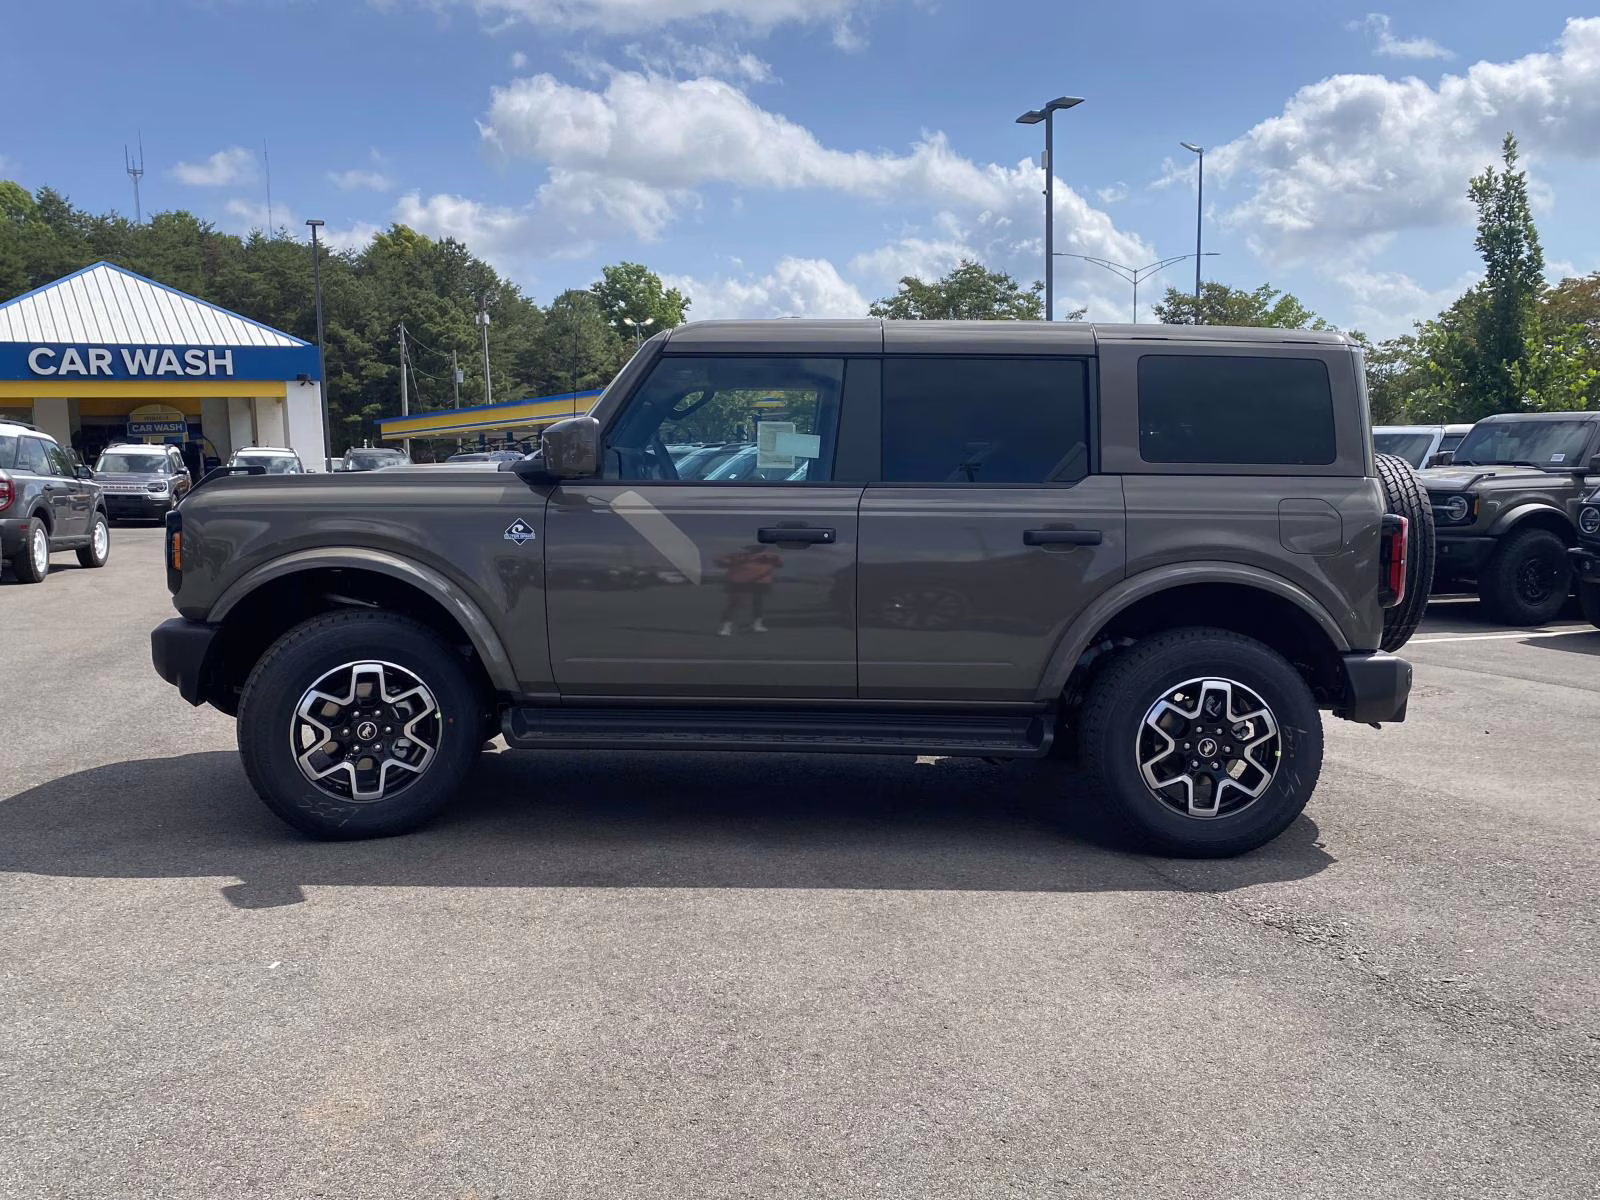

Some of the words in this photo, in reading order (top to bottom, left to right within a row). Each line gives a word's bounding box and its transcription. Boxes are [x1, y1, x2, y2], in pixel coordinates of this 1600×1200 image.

[27, 347, 114, 376] CAR
[120, 348, 234, 376] WASH
[132, 424, 153, 432] CAR
[154, 423, 183, 432] WASH
